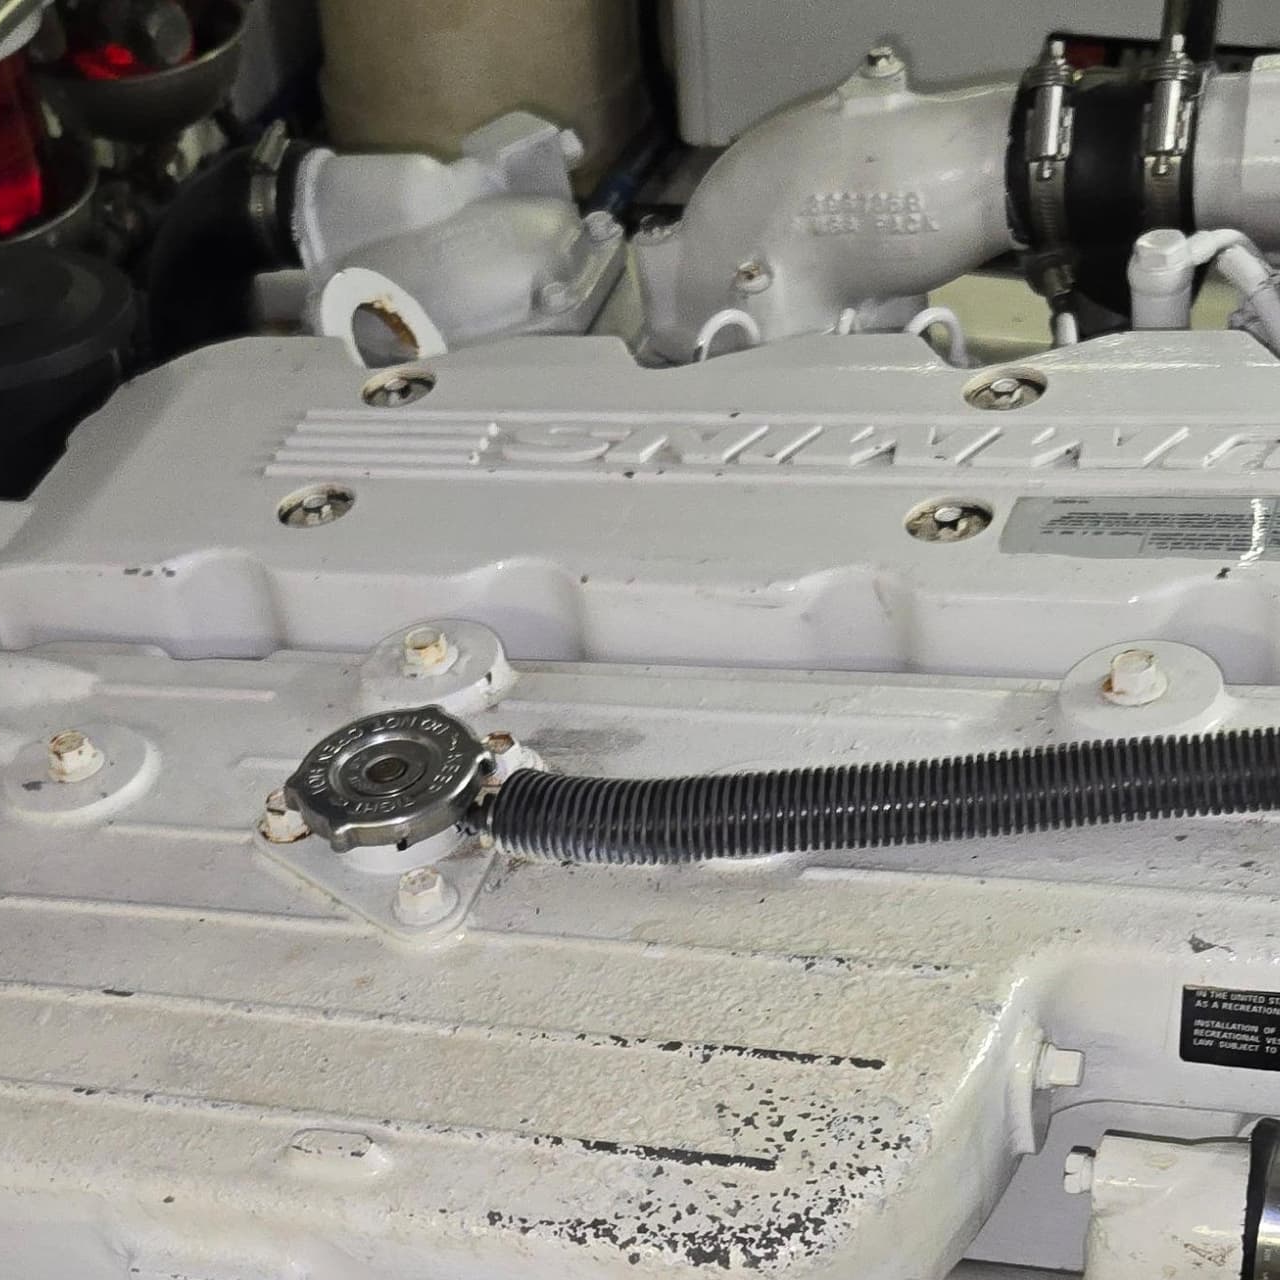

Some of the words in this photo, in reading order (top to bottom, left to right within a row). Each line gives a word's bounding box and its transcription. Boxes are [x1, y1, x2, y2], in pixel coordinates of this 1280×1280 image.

[1195, 1000, 1209, 1009] AS
[1210, 991, 1228, 1000] THE
[1230, 993, 1265, 1004] UNITED
[1193, 1019, 1259, 1033] INSTALLATION
[1263, 1027, 1276, 1035] OF
[1193, 1028, 1260, 1043] RECREATIONAL
[1192, 1038, 1214, 1047] LAW
[1219, 1041, 1260, 1052] SUBJECT
[1265, 1046, 1278, 1054] TO
